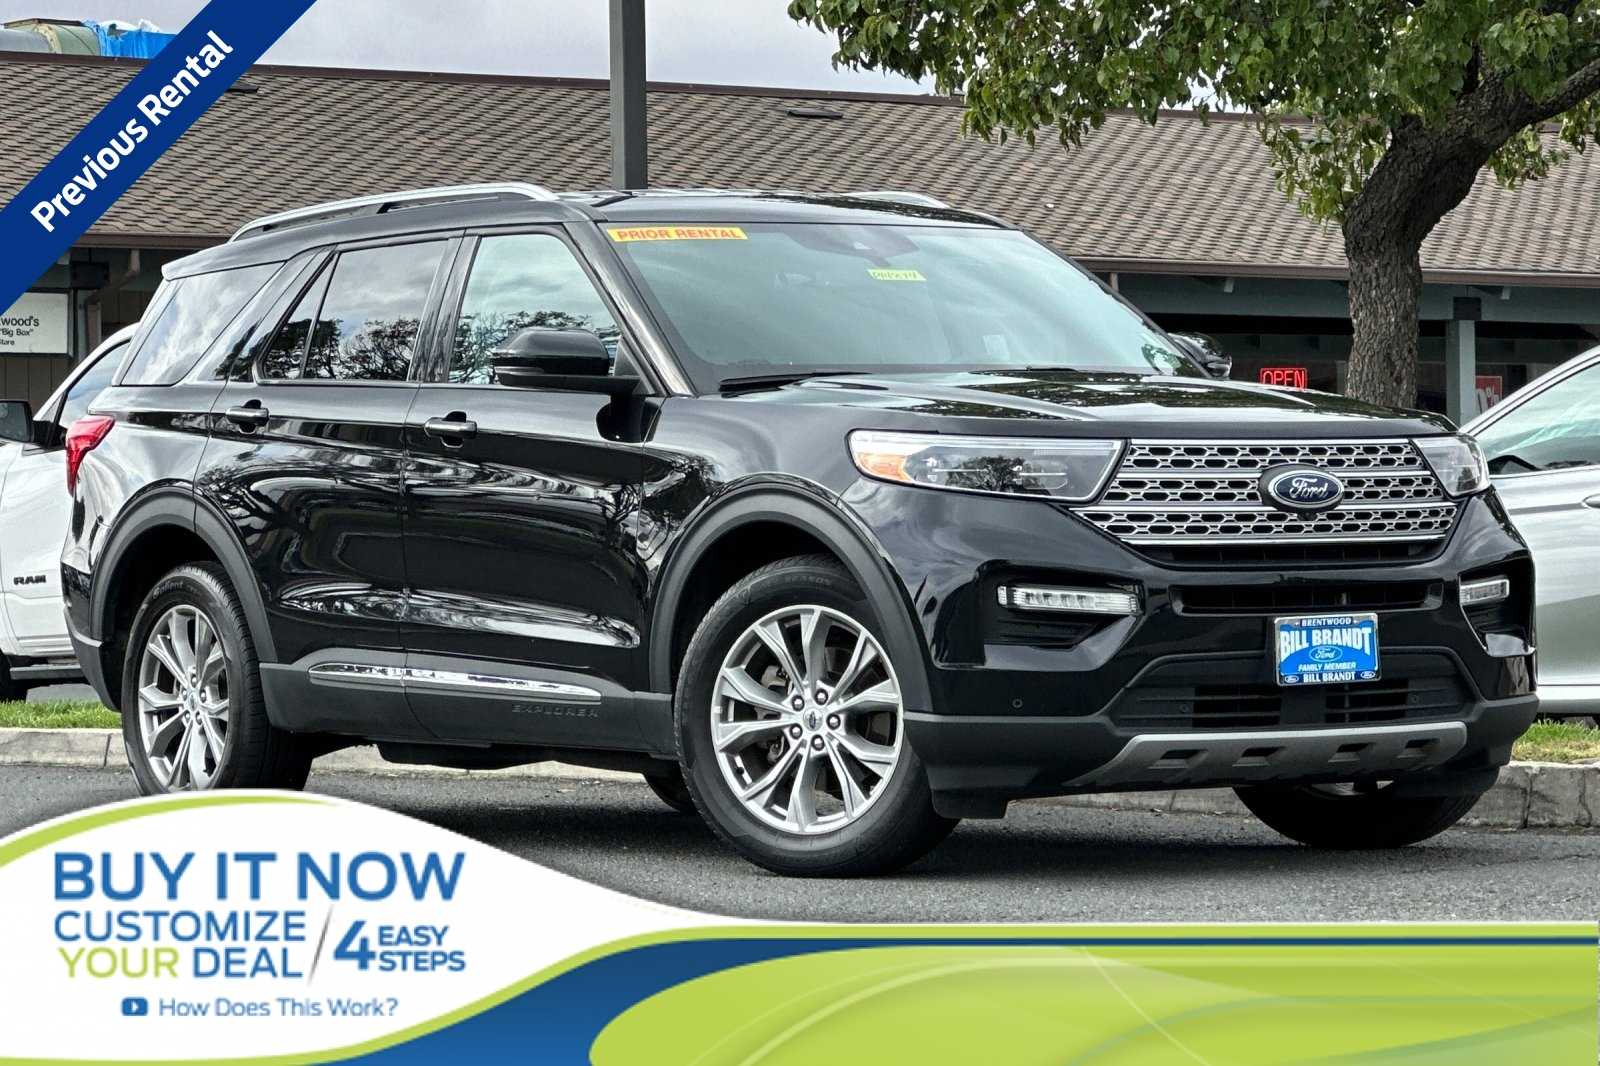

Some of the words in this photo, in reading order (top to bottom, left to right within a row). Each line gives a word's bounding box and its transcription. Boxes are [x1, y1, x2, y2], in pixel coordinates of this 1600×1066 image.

[616, 230, 671, 240] PRIOR
[674, 228, 741, 239] RENTAL
[0, 315, 40, 327] wood's
[1262, 370, 1305, 389] OPEN
[1289, 477, 1328, 499] Ford
[13, 575, 47, 585] RAM
[1301, 617, 1352, 627] BRENTWOOD
[1280, 630, 1310, 662] BILL
[1311, 627, 1372, 656] BRANDT
[1298, 663, 1323, 671] FAMILY
[1323, 661, 1357, 670] MEMBER
[1303, 673, 1321, 683] BILL
[1322, 671, 1356, 681] BRANDT
[511, 704, 600, 718] EXPLORER
